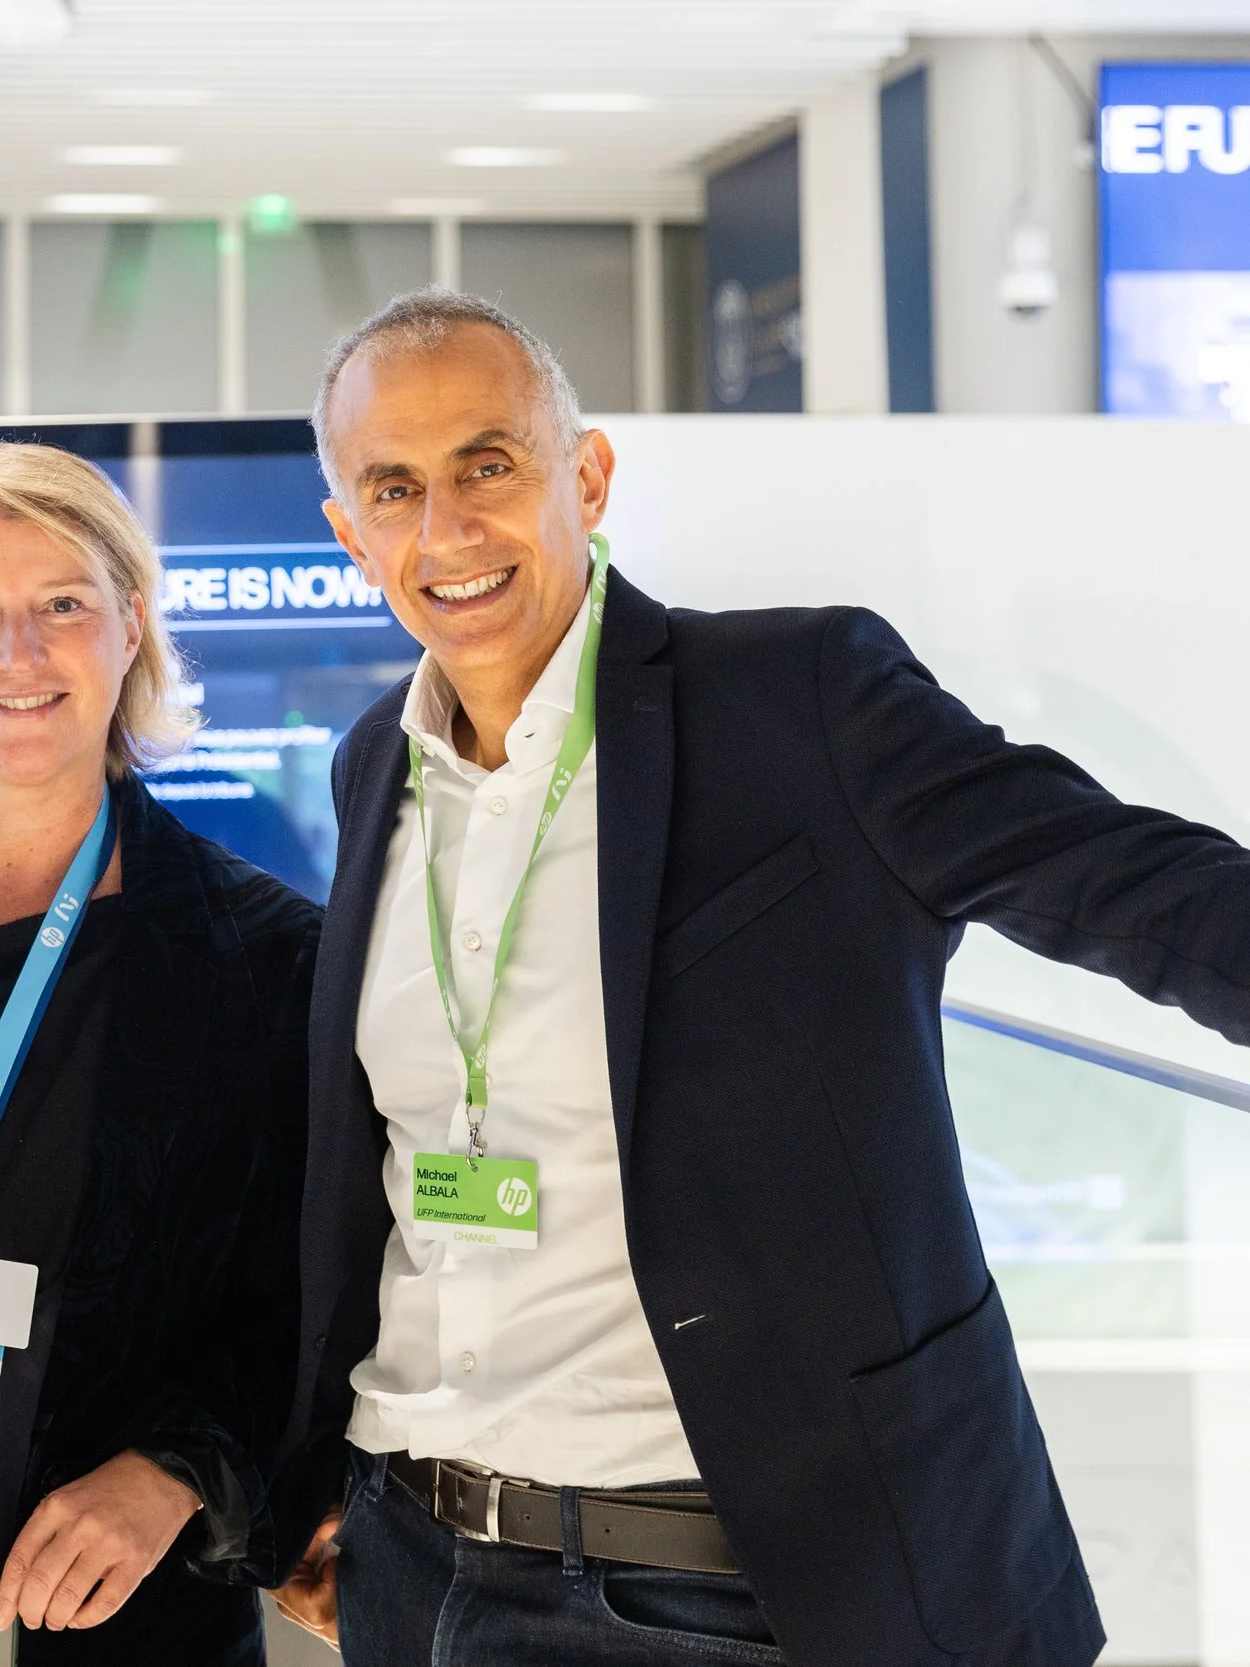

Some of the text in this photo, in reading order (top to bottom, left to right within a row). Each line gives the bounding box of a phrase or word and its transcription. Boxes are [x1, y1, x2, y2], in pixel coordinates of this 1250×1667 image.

[228, 567, 270, 610] IS
[41, 927, 64, 946] hp
[416, 1168, 458, 1182] Michael
[416, 1184, 459, 1199] ALBALA
[499, 1177, 530, 1216] hp
[416, 1208, 486, 1222] UFP International
[453, 1231, 500, 1245] CHANNEL
